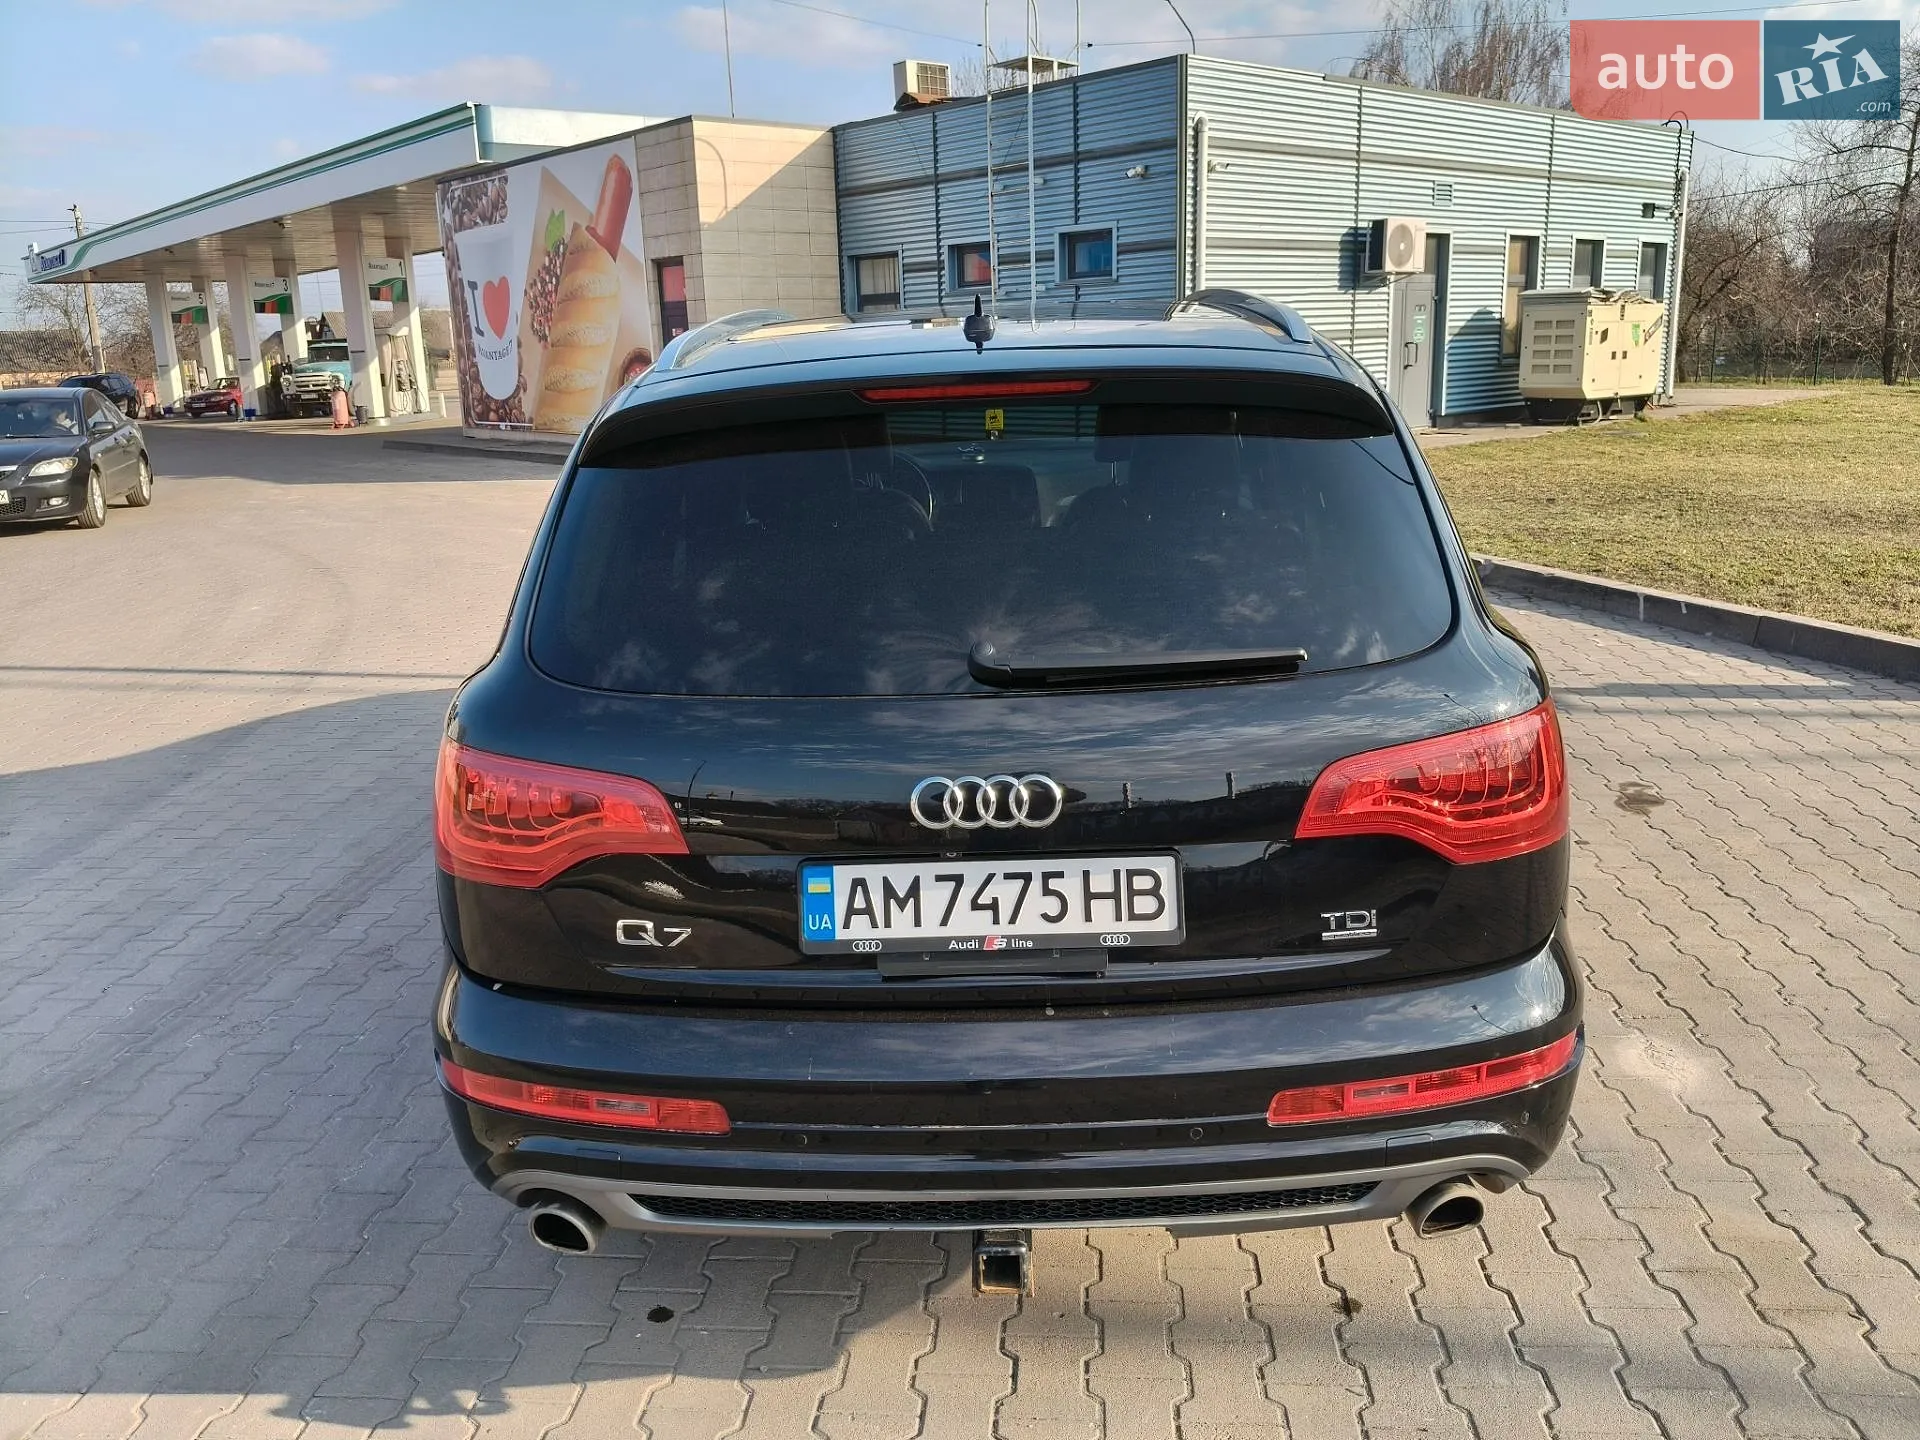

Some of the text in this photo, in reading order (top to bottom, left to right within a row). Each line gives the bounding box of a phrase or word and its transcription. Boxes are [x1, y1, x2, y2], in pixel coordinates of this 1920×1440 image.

[283, 279, 289, 292] 3
[198, 293, 204, 304] 5
[808, 914, 832, 930] UA
[1320, 909, 1377, 930] TDI
[616, 920, 692, 947] Q7
[948, 939, 979, 949] Audi
[1011, 938, 1033, 948] line
